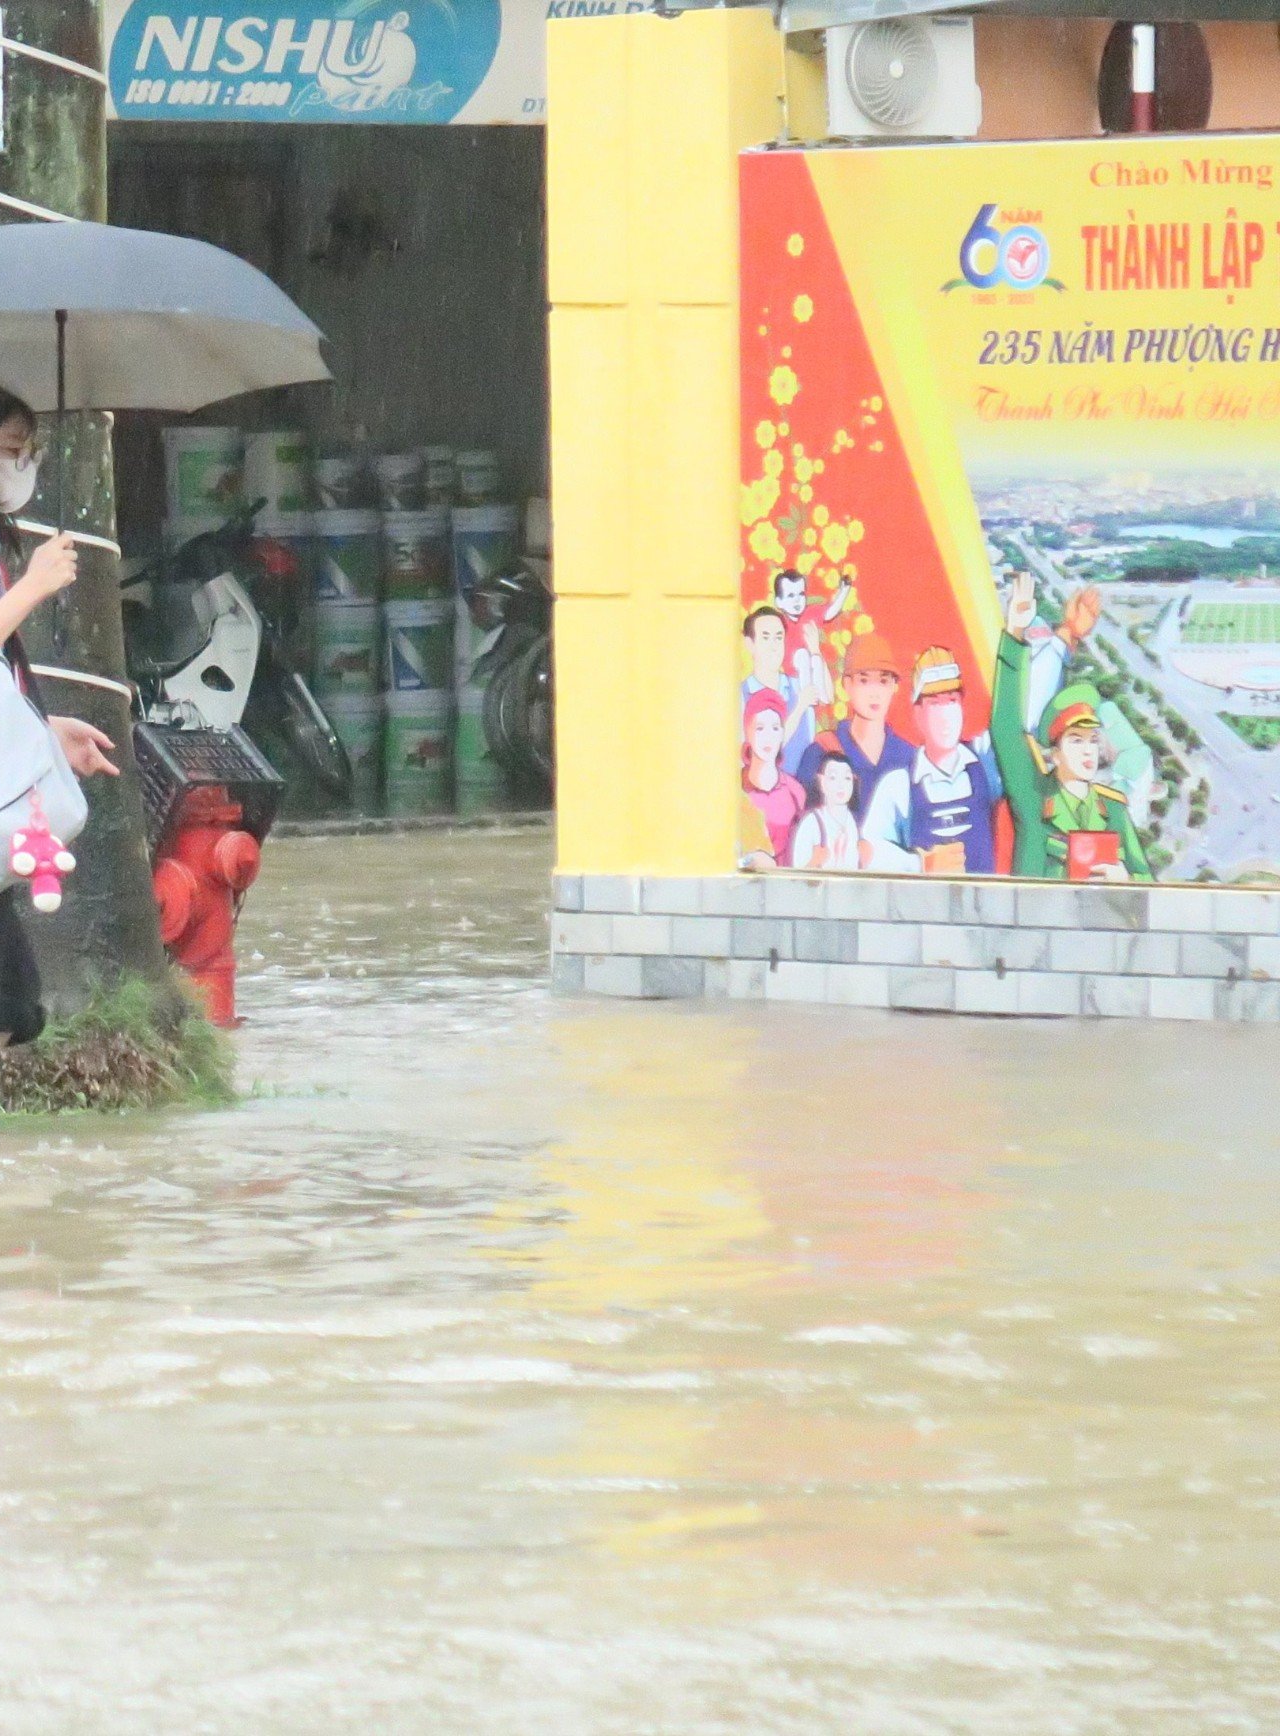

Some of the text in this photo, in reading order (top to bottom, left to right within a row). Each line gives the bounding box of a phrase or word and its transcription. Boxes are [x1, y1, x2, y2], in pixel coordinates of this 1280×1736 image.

[135, 15, 386, 76] NISHU
[125, 79, 166, 104] ISO
[235, 81, 293, 106] 2000
[1182, 157, 1273, 191] Mừng
[1000, 206, 1043, 223] NĂM
[959, 203, 1050, 291] 60
[1080, 207, 1265, 305] THÀNH LẬP
[978, 330, 1042, 365] 235
[1047, 321, 1115, 364] NĂM
[1123, 323, 1254, 373] PHƯỢNG
